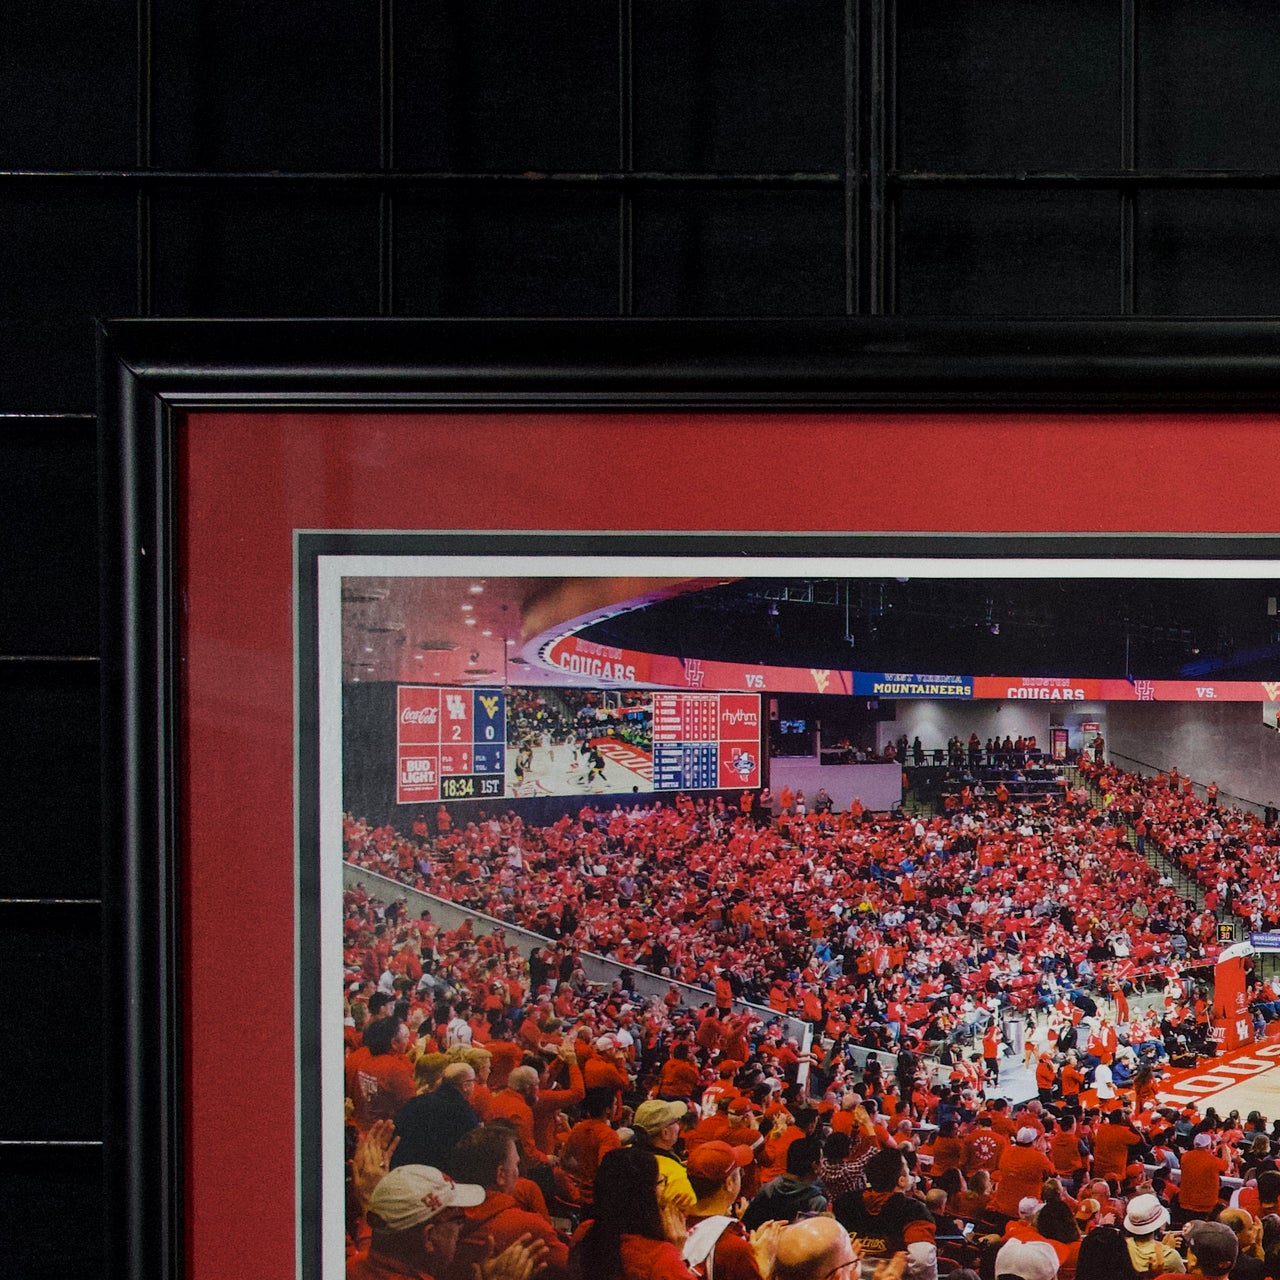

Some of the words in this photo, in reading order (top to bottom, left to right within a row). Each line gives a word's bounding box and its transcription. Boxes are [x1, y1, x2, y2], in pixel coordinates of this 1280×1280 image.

[560, 652, 636, 682] COUGARS
[746, 674, 766, 689] VS.
[873, 683, 971, 695] MOUNTAINEERS
[1007, 688, 1085, 700] COUGARS
[1196, 687, 1217, 698] VS.
[722, 709, 757, 725] rhythm
[452, 725, 461, 740] 2
[485, 725, 494, 740] 0
[406, 760, 430, 772] BUD
[402, 771, 435, 784] LIGHT
[443, 779, 474, 796] 18:34
[481, 780, 500, 793] 1ST
